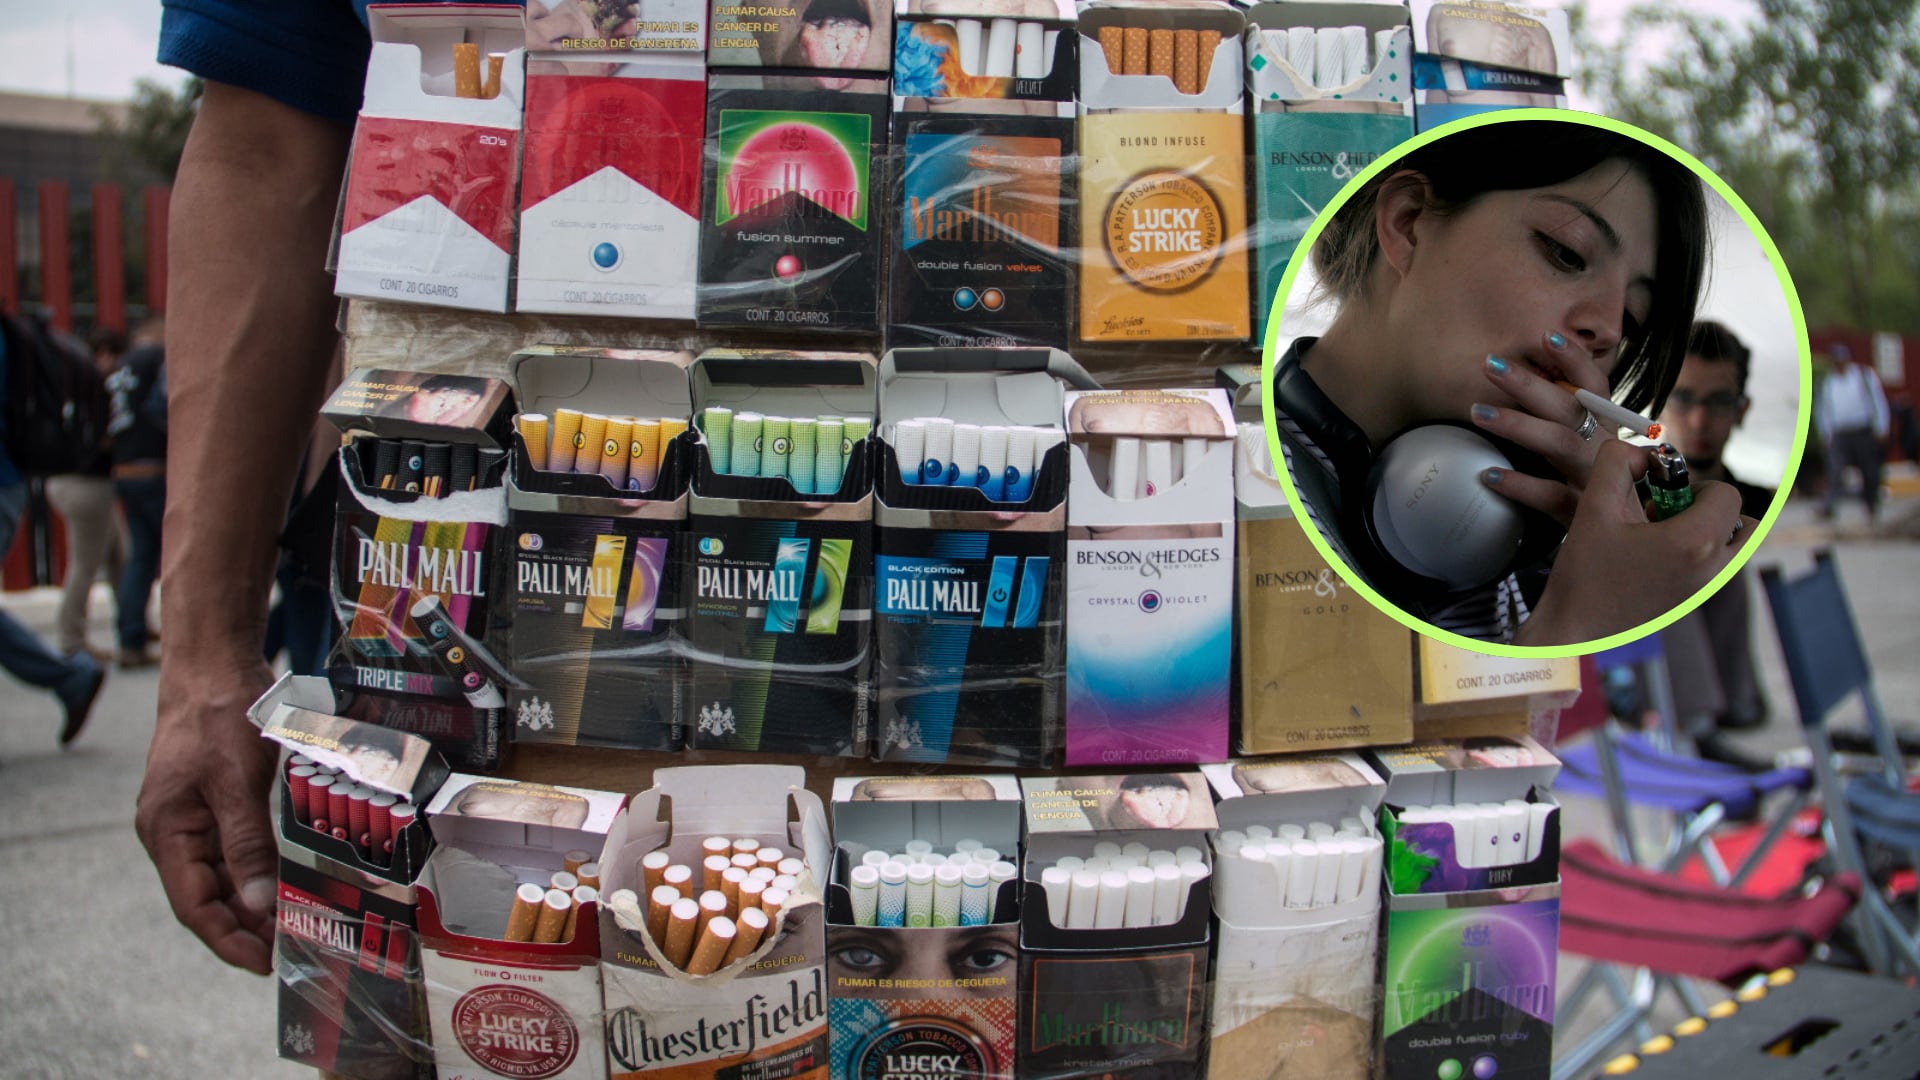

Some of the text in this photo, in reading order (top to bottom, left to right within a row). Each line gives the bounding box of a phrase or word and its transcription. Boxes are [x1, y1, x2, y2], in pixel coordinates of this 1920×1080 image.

[715, 6, 797, 17] FUMAR CAUSA
[636, 22, 699, 33] FUMAR ES
[764, 22, 779, 32] DE
[562, 38, 698, 49] RIESGO DE GANGRENA
[713, 37, 760, 49] LENGUA
[1015, 80, 1043, 95] VELVET
[479, 135, 508, 146] 20's
[1120, 136, 1206, 146] BLOND INFUSE
[1271, 152, 1334, 165] BENSON
[721, 162, 862, 221] Marlboro
[1132, 207, 1200, 230] LUCKY
[737, 231, 845, 245] fusion summer
[1128, 230, 1202, 254] STRIKE
[917, 260, 1043, 272] double fusion velvet
[380, 278, 459, 299] CONT. 20 CIGARROS
[746, 309, 830, 324] CONT. 20 CIGARROS
[964, 336, 976, 347] 20
[976, 336, 1018, 348] CIGARROS
[1406, 463, 1440, 512] SONY
[1077, 550, 1142, 565] BENSON
[1156, 547, 1220, 563] HEDGES
[358, 538, 486, 597] PALL MALL
[888, 564, 965, 575] BLACK EDITION
[517, 561, 615, 598] PALL MALL
[697, 565, 799, 601] PALL MALL
[1256, 571, 1318, 588] BENSON
[887, 578, 981, 613] PALL MALL
[1088, 595, 1208, 606] CRYSTAL VIOLET
[1303, 605, 1349, 615] GOLD
[356, 666, 434, 695] TRIPLE MIX
[1456, 669, 1553, 689] CONT. 20 CIGARROS
[1327, 725, 1371, 740] CIGARROS
[1132, 750, 1142, 761] 20
[1144, 749, 1189, 761] CIGARROS
[1030, 788, 1114, 798] FUMAR CAUSA
[1082, 799, 1099, 808] DE
[1034, 812, 1081, 820] LENGUA
[1489, 870, 1512, 884] RUBY
[284, 904, 358, 954] PALL MALL
[617, 952, 657, 968] FUMAR
[473, 968, 544, 983] FLOW FILTER
[837, 976, 1007, 988] FUMAR ES RIESGO DE CEGUERA
[1391, 961, 1549, 1025] Marlboro
[507, 992, 554, 1017] TOBACCO
[479, 1012, 549, 1035] LUCKY
[608, 968, 825, 1072] Chesterfield
[1039, 1001, 1182, 1046] Marlboro
[477, 1029, 554, 1054] STRIKE
[920, 1030, 966, 1053] TOBACCO
[1408, 1032, 1530, 1048] double fusion ruby
[886, 1055, 961, 1073] LUCKY
